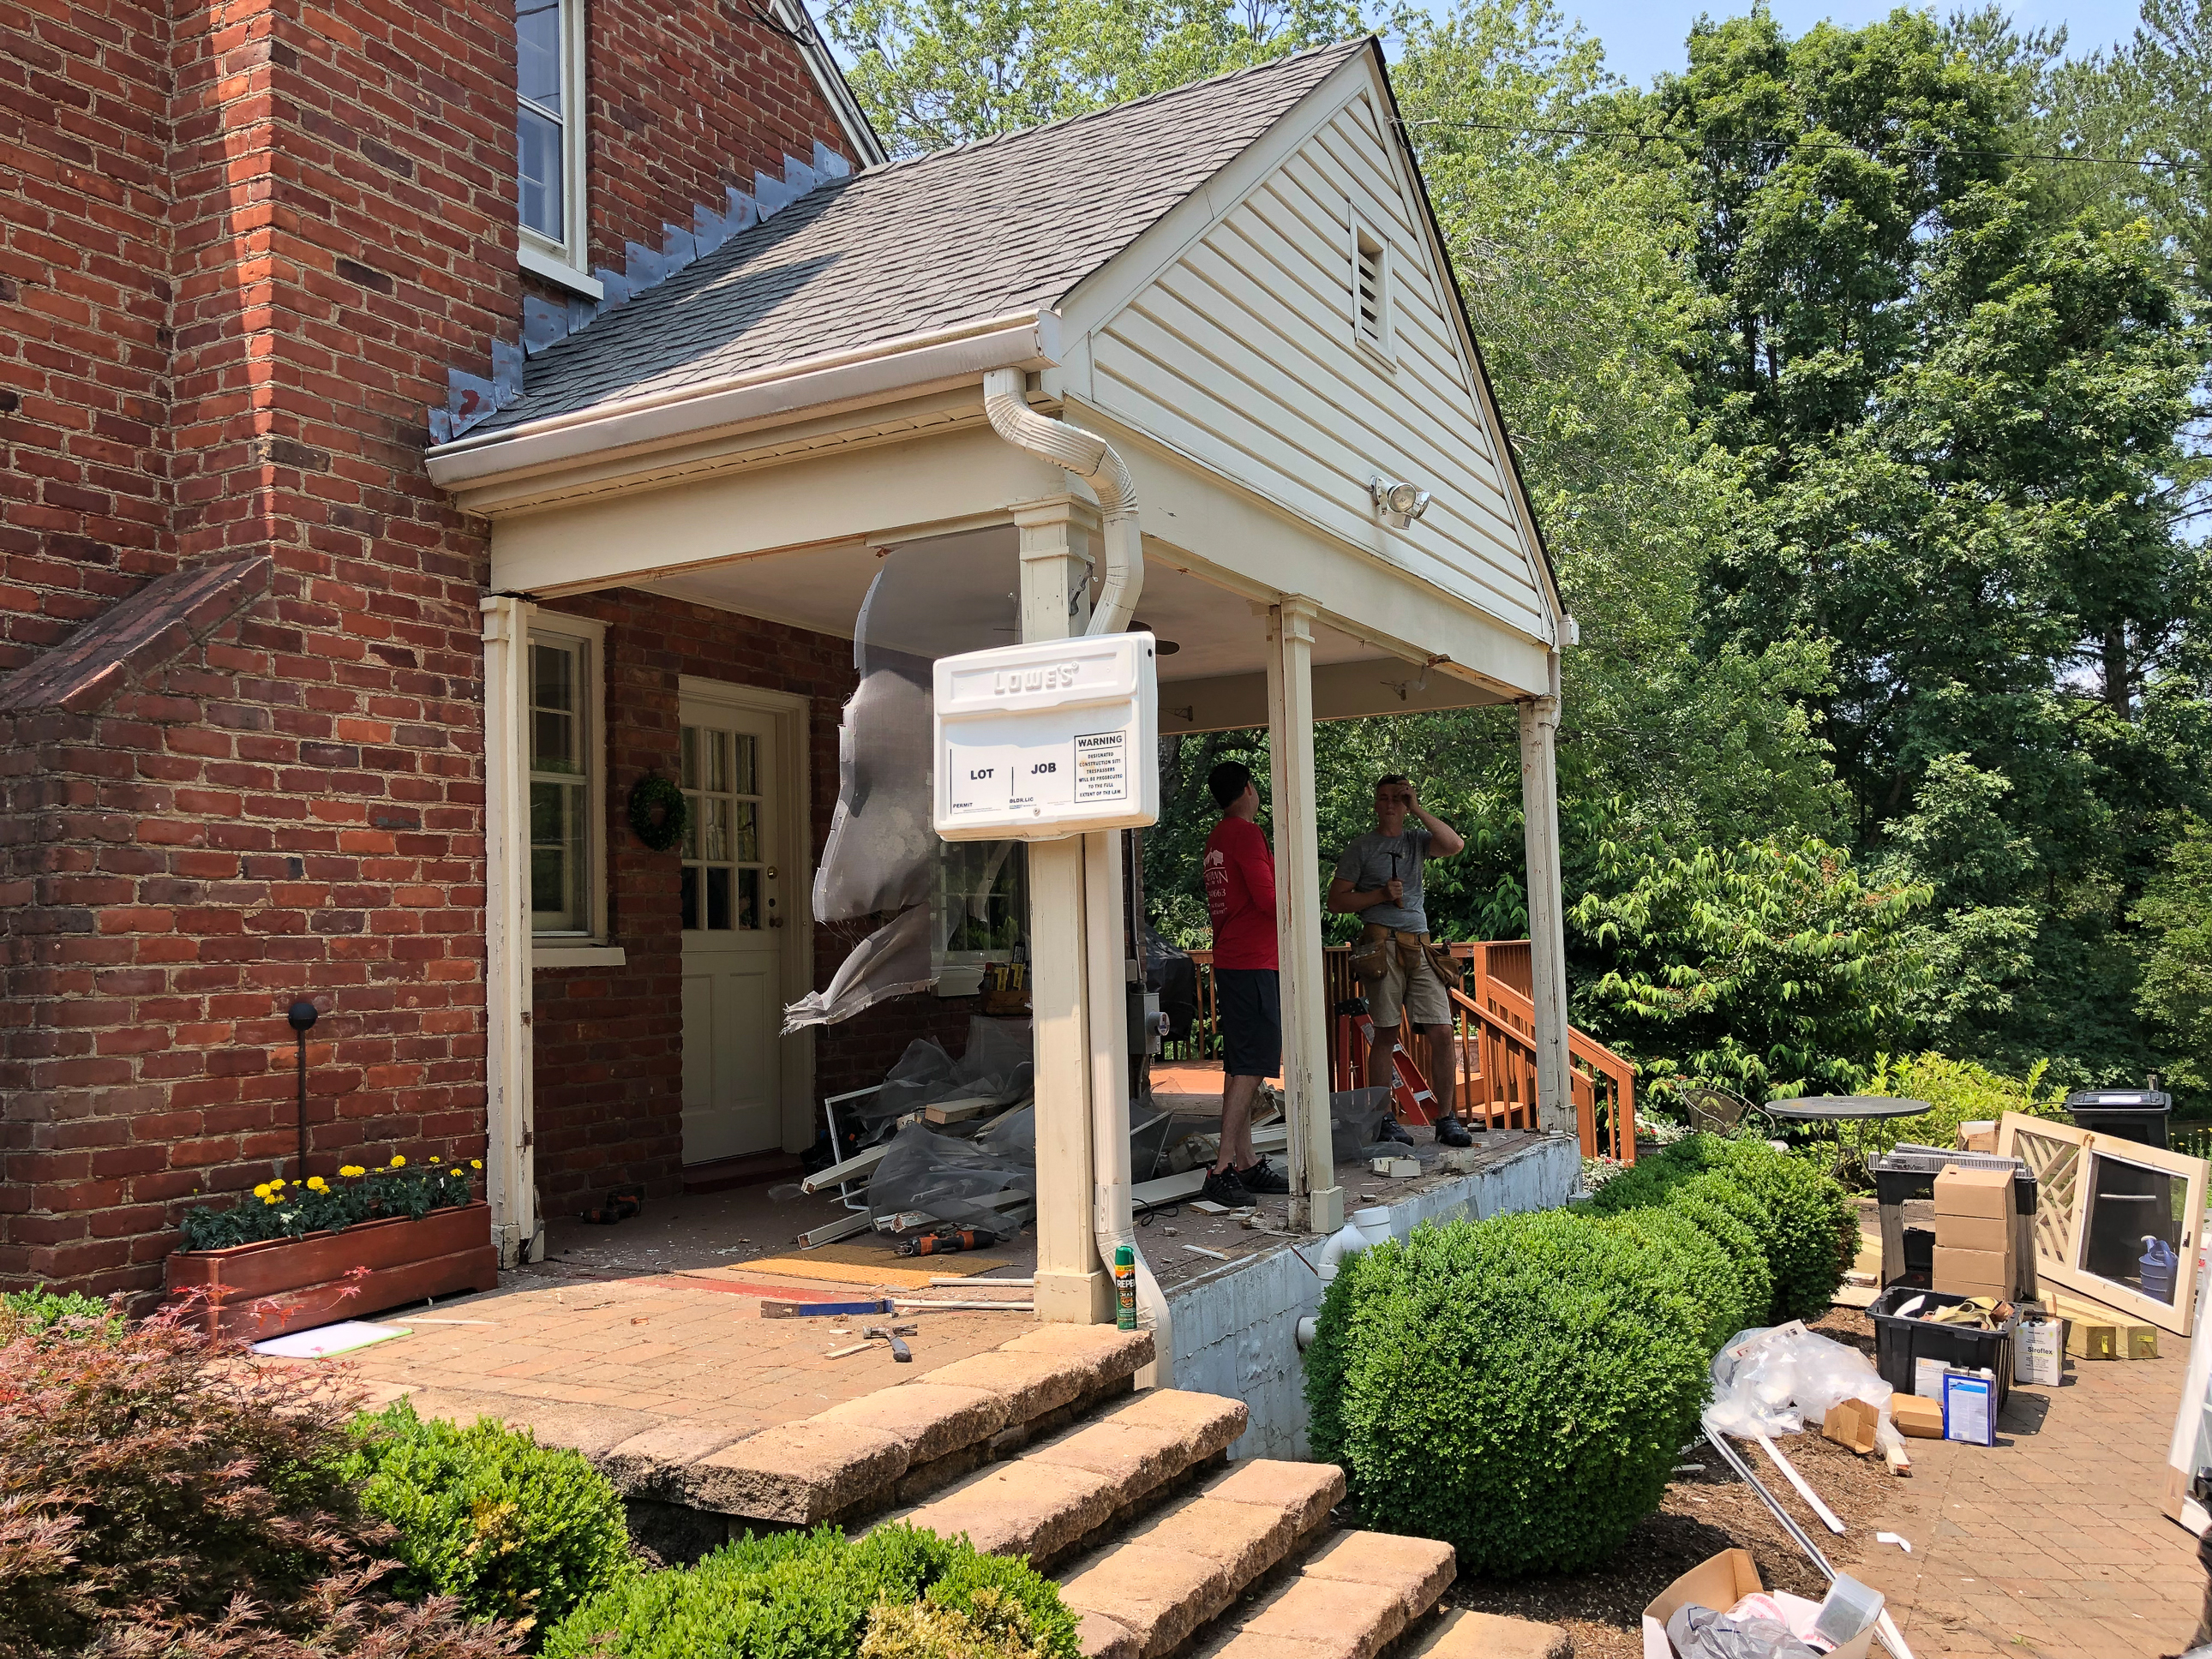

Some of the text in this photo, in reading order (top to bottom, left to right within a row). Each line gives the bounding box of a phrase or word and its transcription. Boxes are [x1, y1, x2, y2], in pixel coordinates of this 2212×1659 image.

[1078, 735, 1122, 747] WARNING
[1031, 762, 1057, 775] JOB
[970, 769, 994, 780] LOT
[1117, 1279, 1136, 1288] REPE
